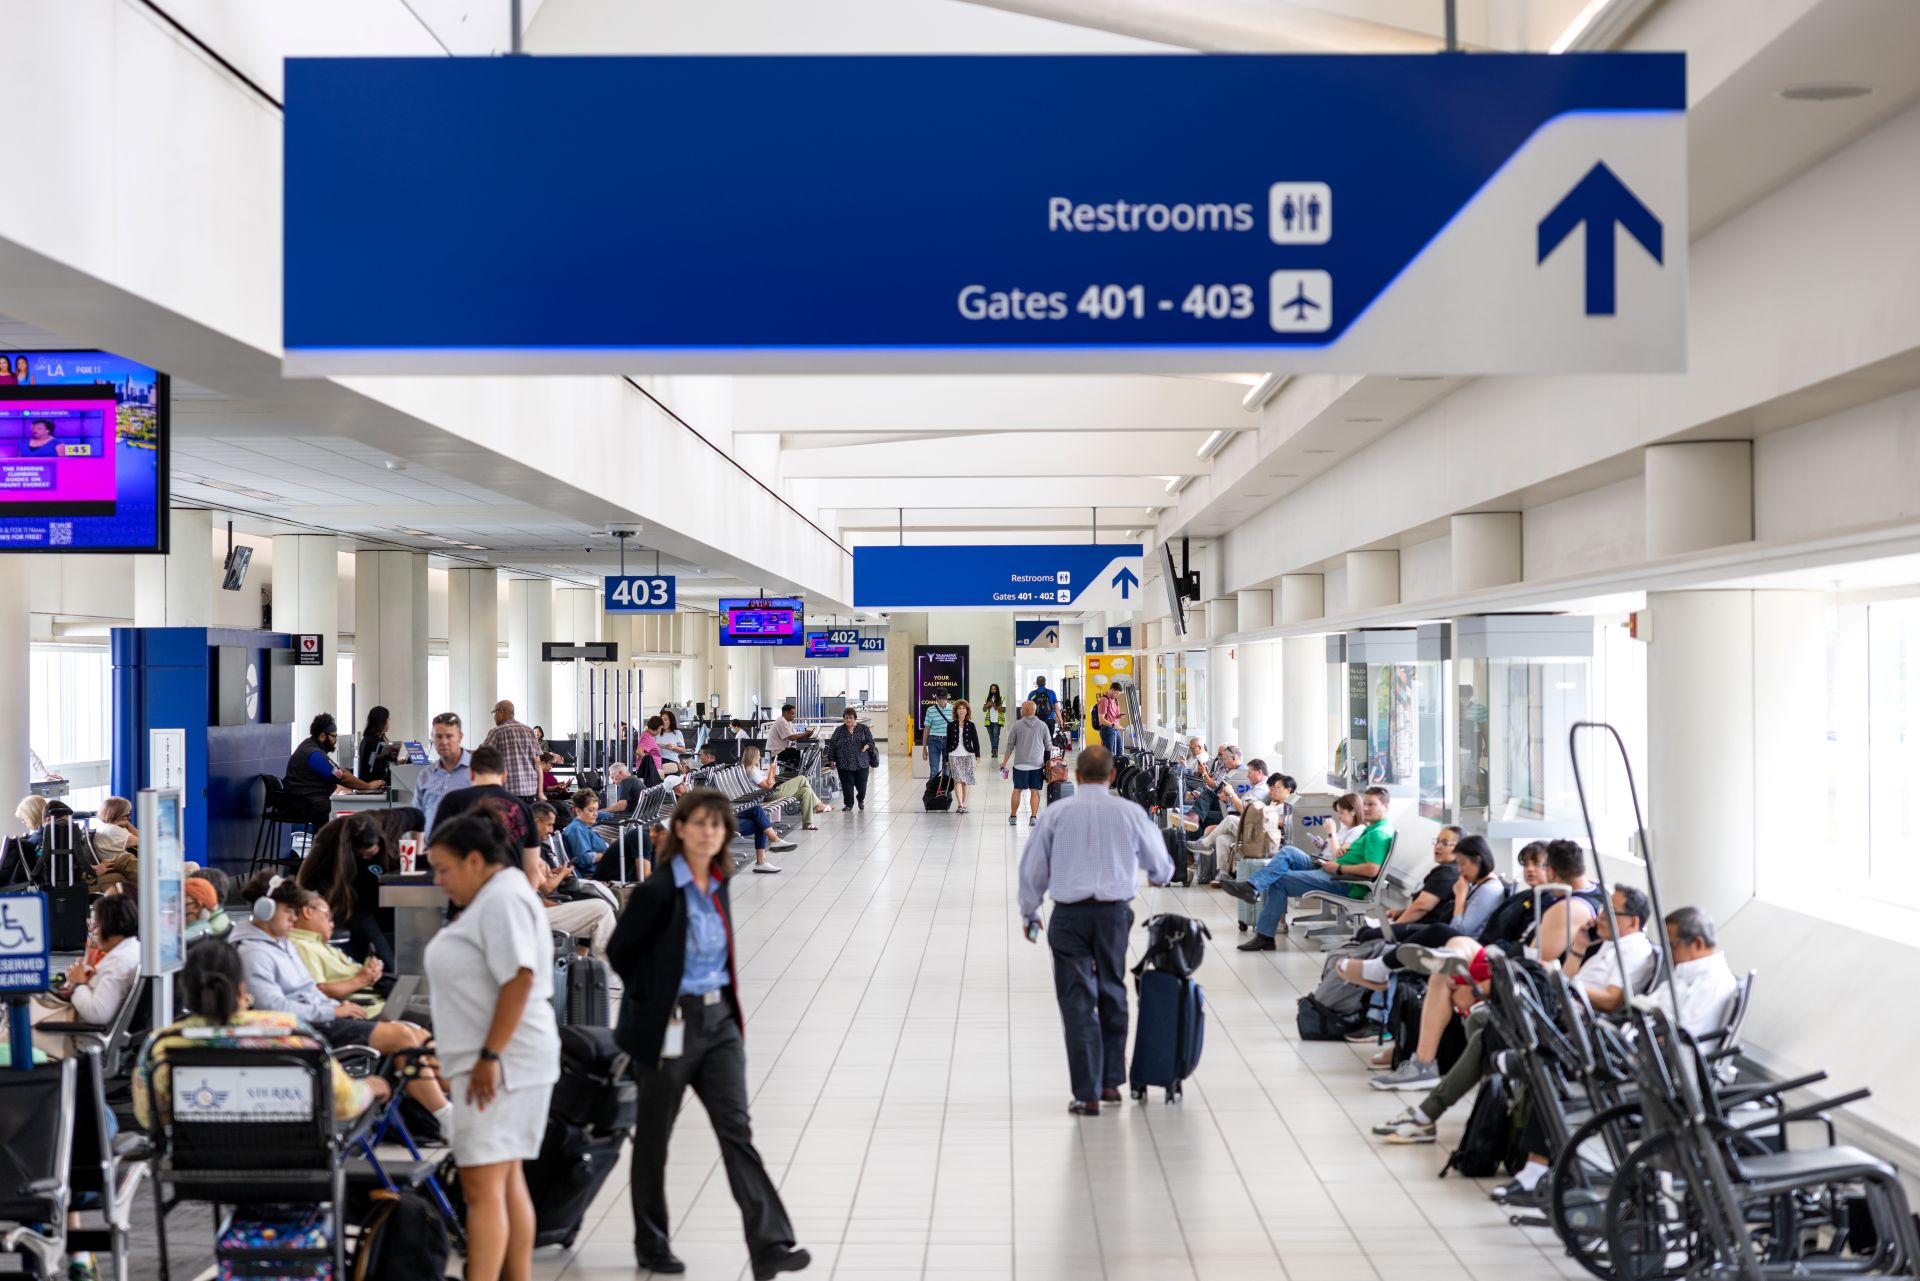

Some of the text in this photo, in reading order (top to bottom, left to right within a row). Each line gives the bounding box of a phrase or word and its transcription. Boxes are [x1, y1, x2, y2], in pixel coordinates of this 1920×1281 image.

[1049, 196, 1254, 232] Restrooms
[957, 284, 1255, 321] Gates 401 - 403
[47, 364, 65, 376] LA
[1011, 573, 1055, 583] Restrooms
[612, 579, 669, 606] 403
[993, 592, 1016, 601] Gates
[1018, 592, 1033, 600] 401
[1039, 592, 1055, 600] 402
[830, 631, 856, 643] 402
[861, 639, 882, 649] 401
